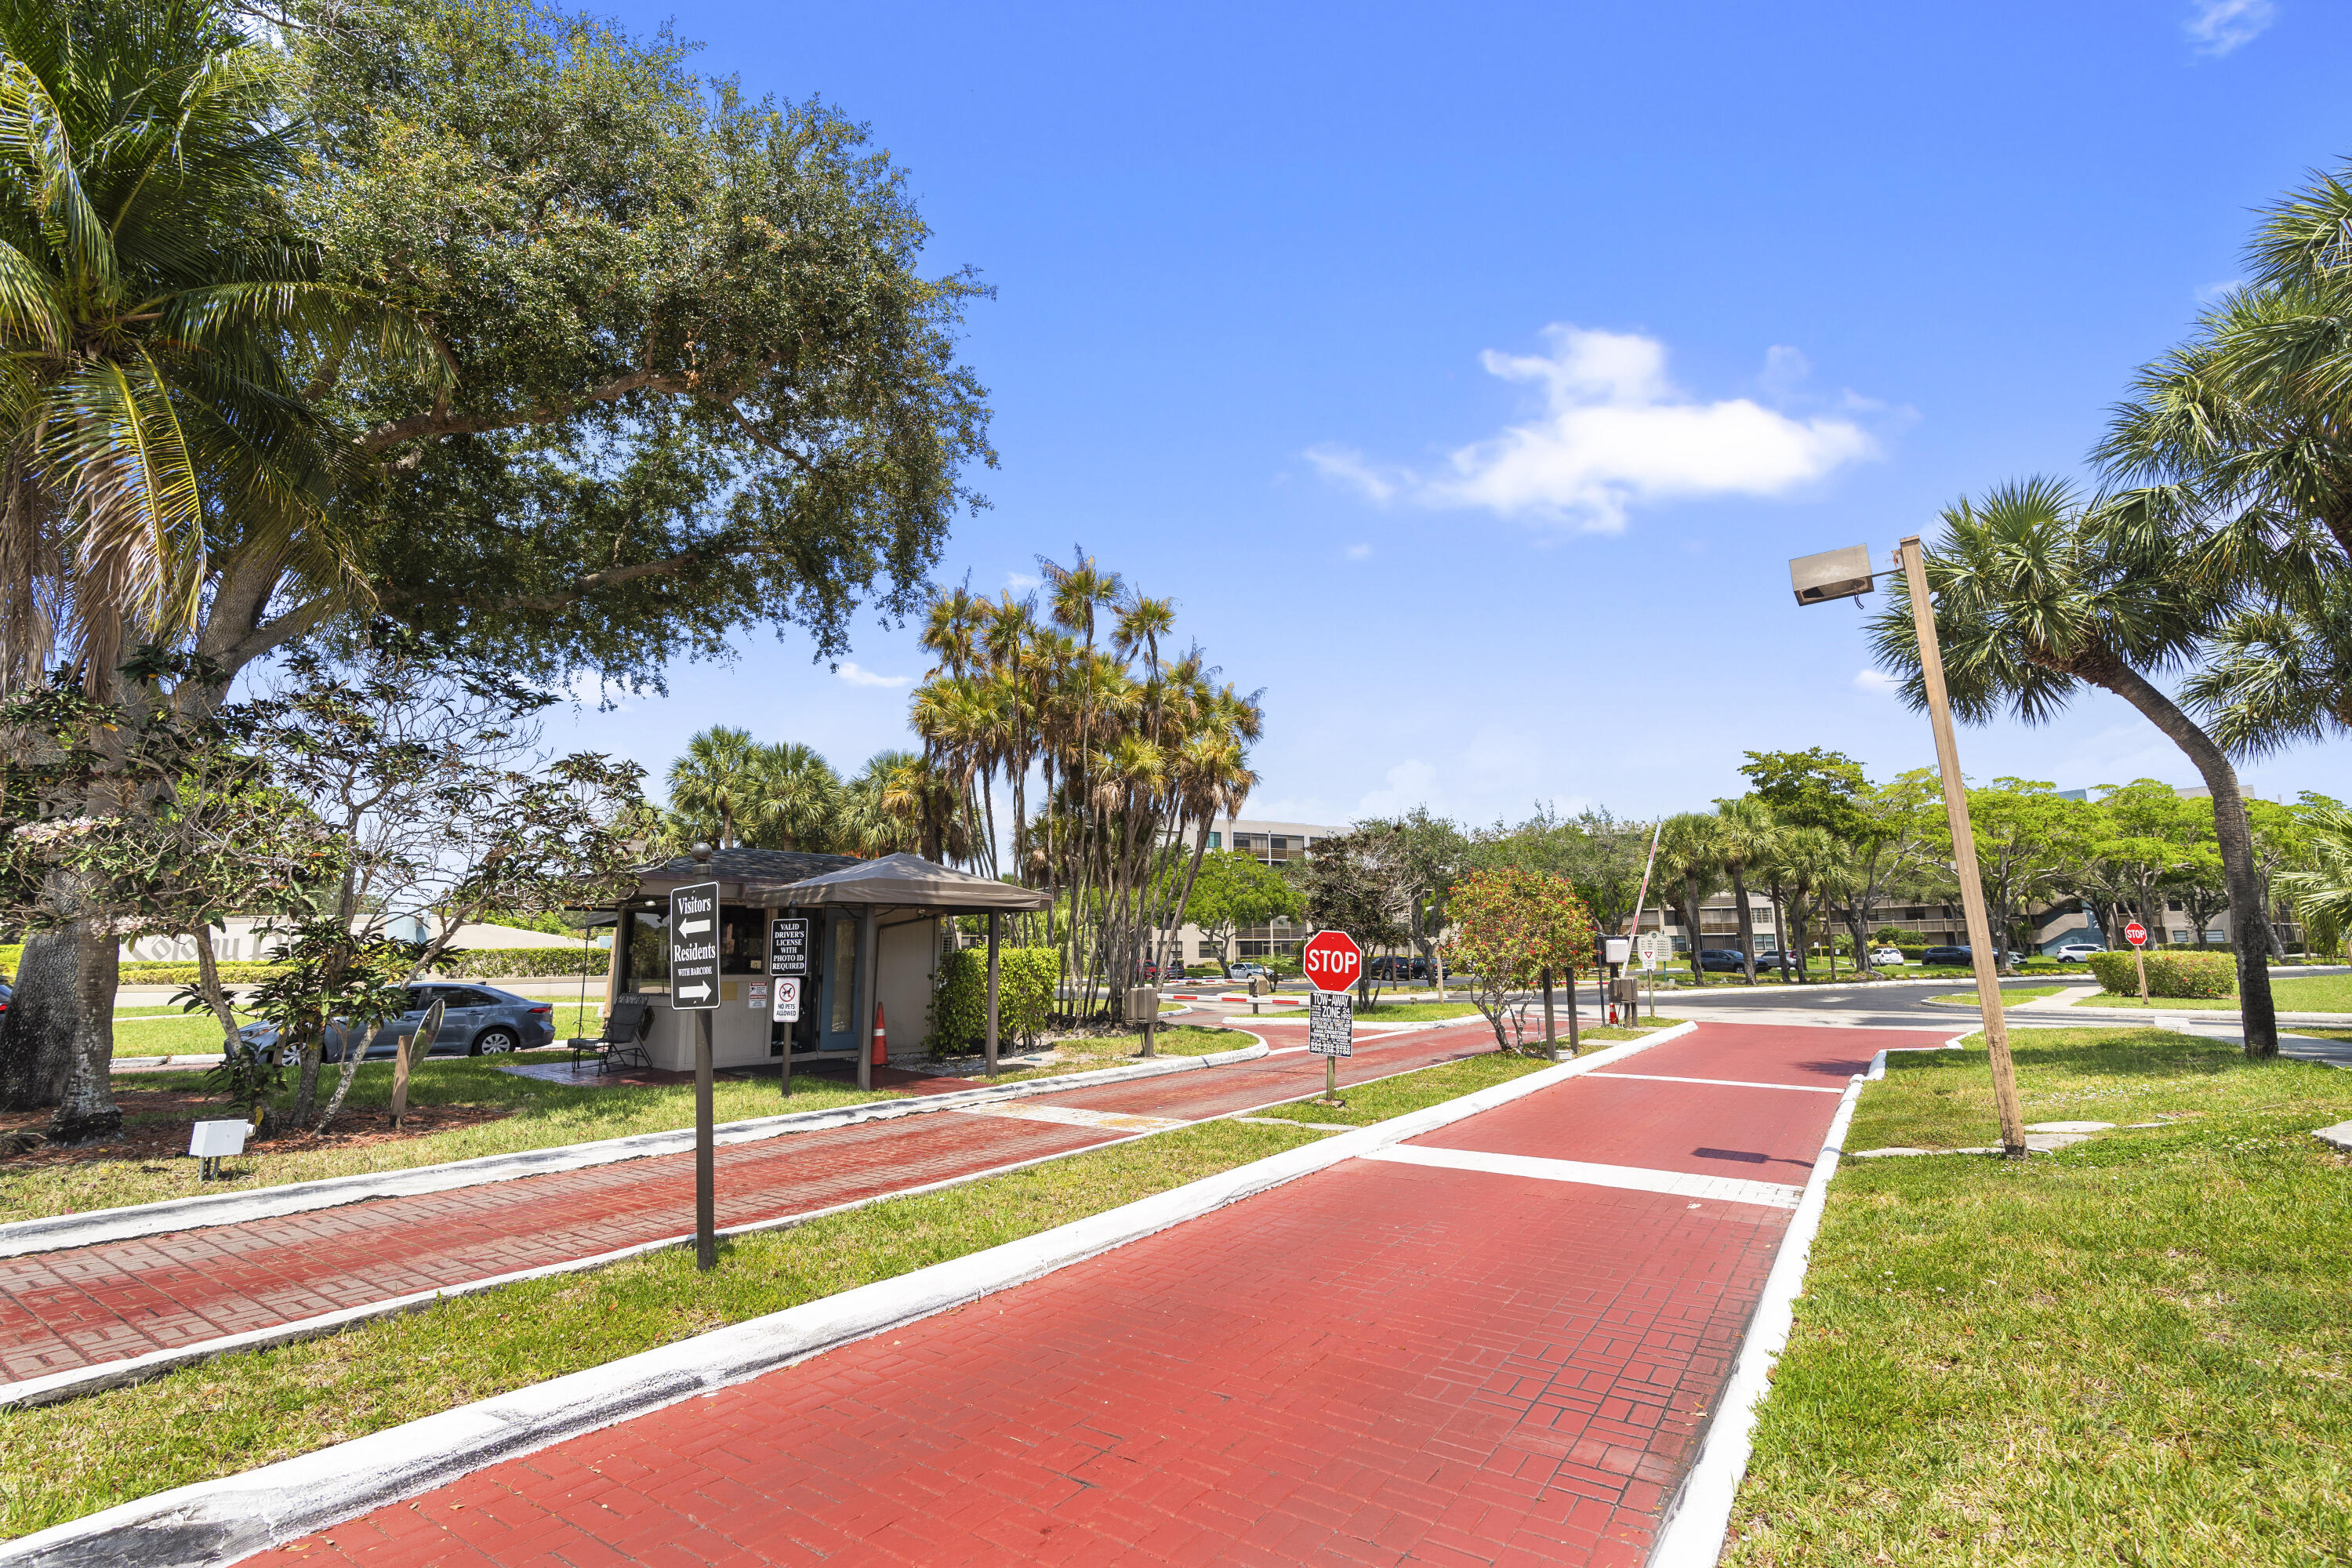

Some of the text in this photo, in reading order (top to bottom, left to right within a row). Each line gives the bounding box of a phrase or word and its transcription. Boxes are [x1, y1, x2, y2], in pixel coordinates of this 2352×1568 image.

[677, 895, 711, 915] Visitors
[2127, 929, 2145, 938] STOP
[673, 942, 716, 962] Residents
[772, 962, 804, 971] REQUIRED
[1308, 949, 1357, 973] STOP
[677, 966, 712, 977] WITH BARCODE
[1313, 993, 1349, 1007] TOW-AWAY
[1322, 1005, 1340, 1018] ZONE
